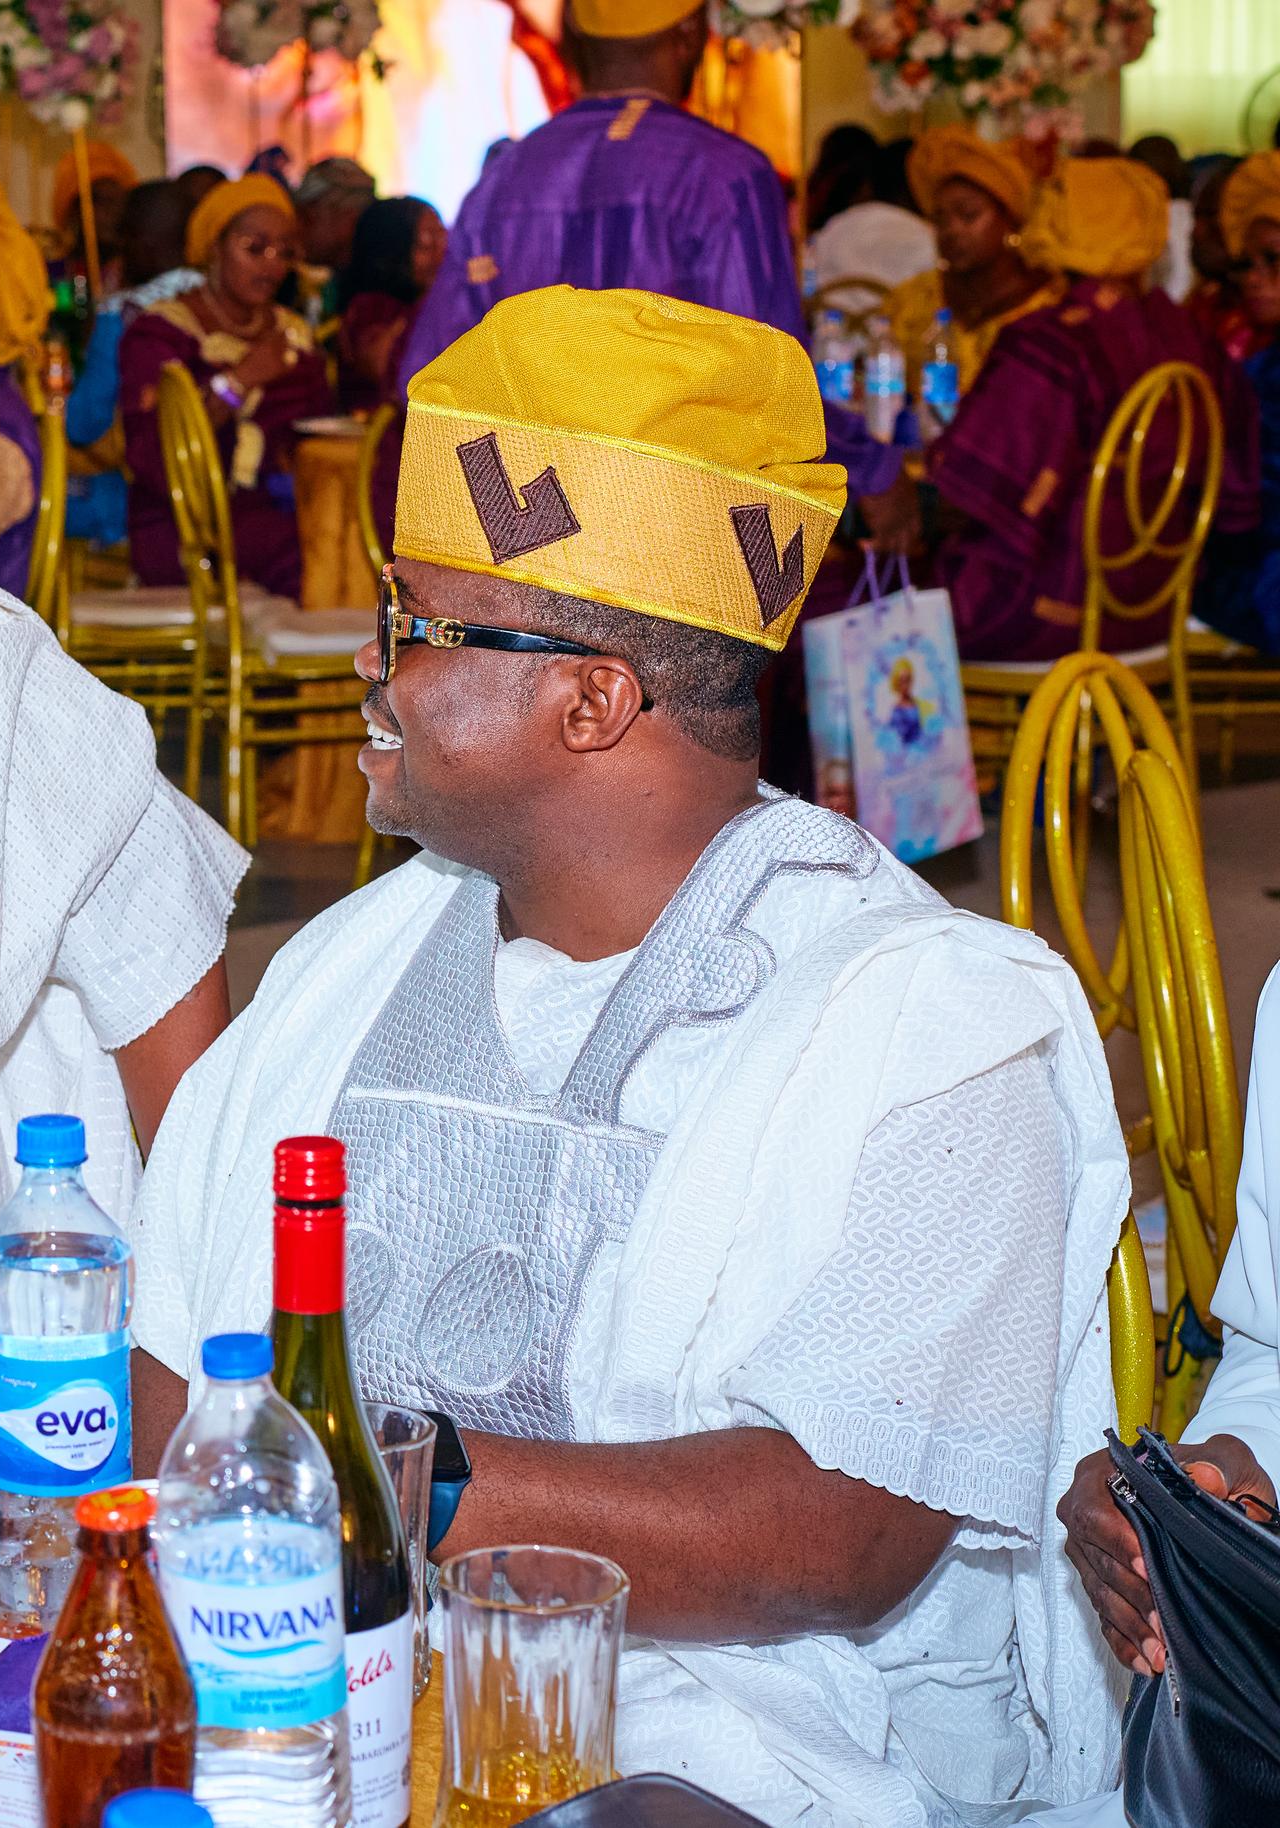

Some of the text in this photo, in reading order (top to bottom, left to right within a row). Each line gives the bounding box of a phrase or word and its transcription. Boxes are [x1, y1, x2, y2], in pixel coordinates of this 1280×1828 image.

[191, 1596, 336, 1640] NIRVANA
[347, 1649, 395, 1693] olds
[352, 1718, 382, 1741] 311
